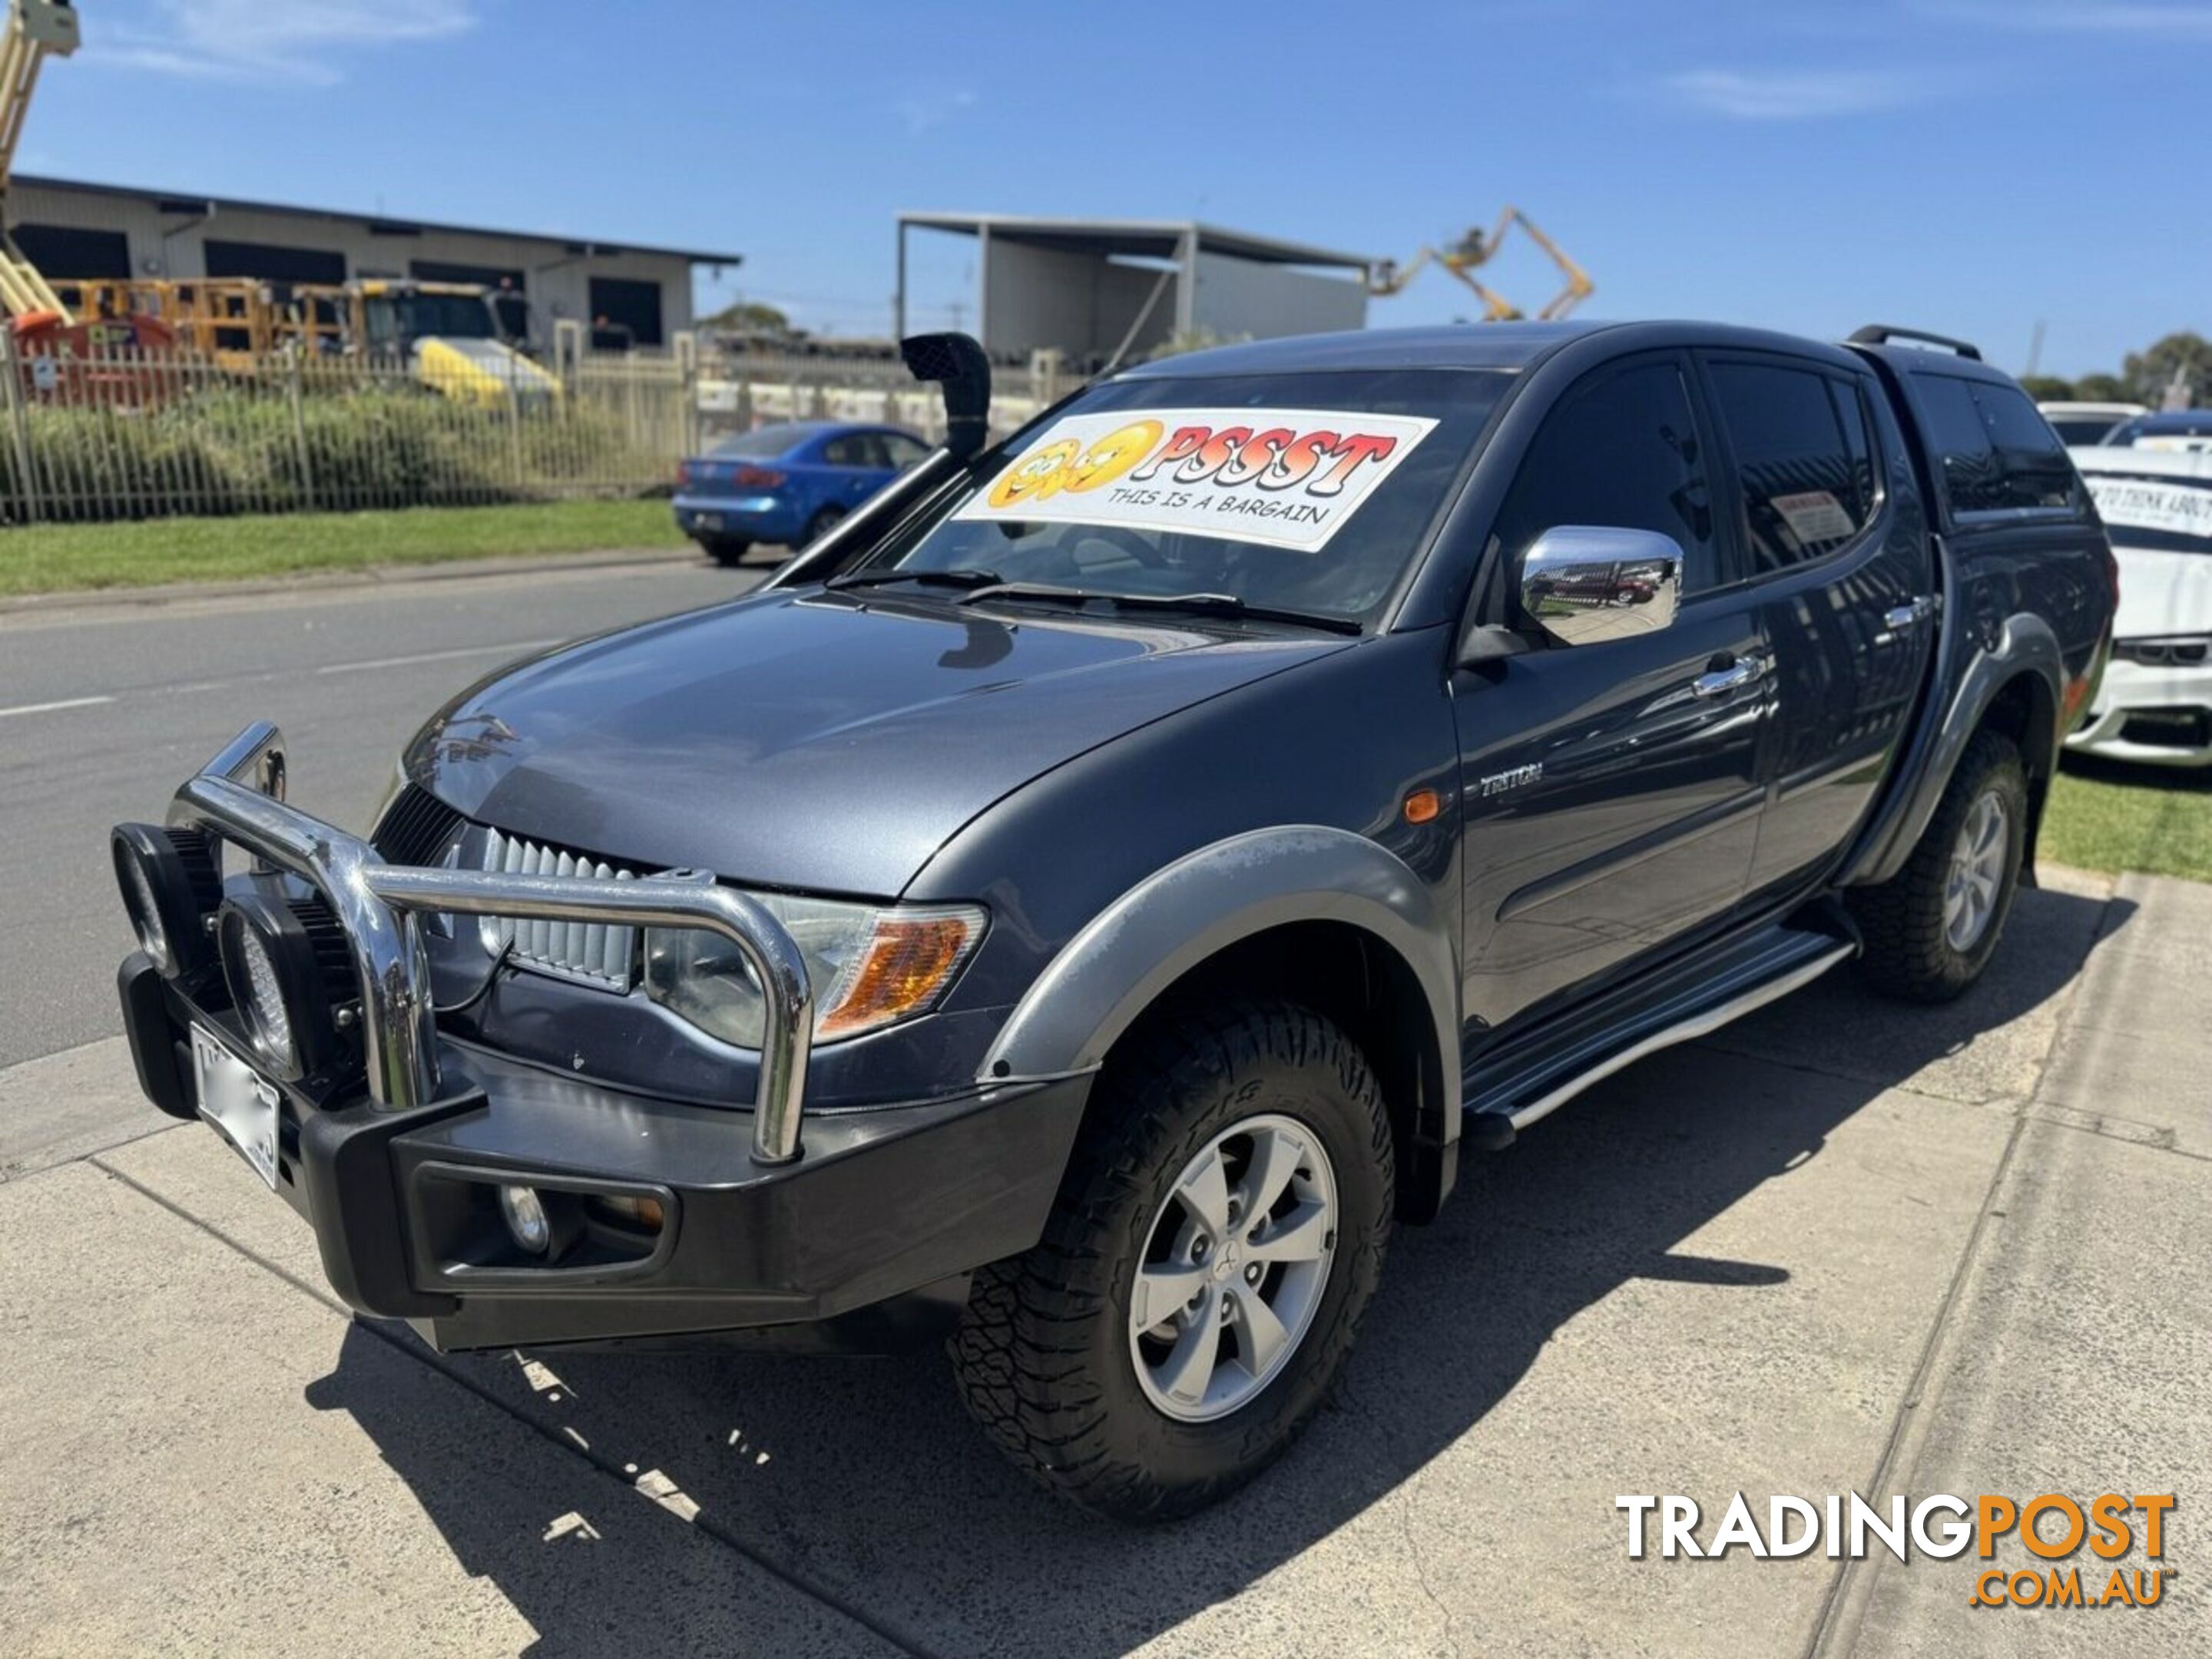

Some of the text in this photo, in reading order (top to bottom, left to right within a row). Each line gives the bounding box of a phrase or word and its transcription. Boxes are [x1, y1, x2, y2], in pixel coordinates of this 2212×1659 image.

[1130, 426, 1398, 498] PSSST
[1108, 488, 1330, 525] THIS IS A BARGAIN
[1480, 761, 1543, 797] TRITON
